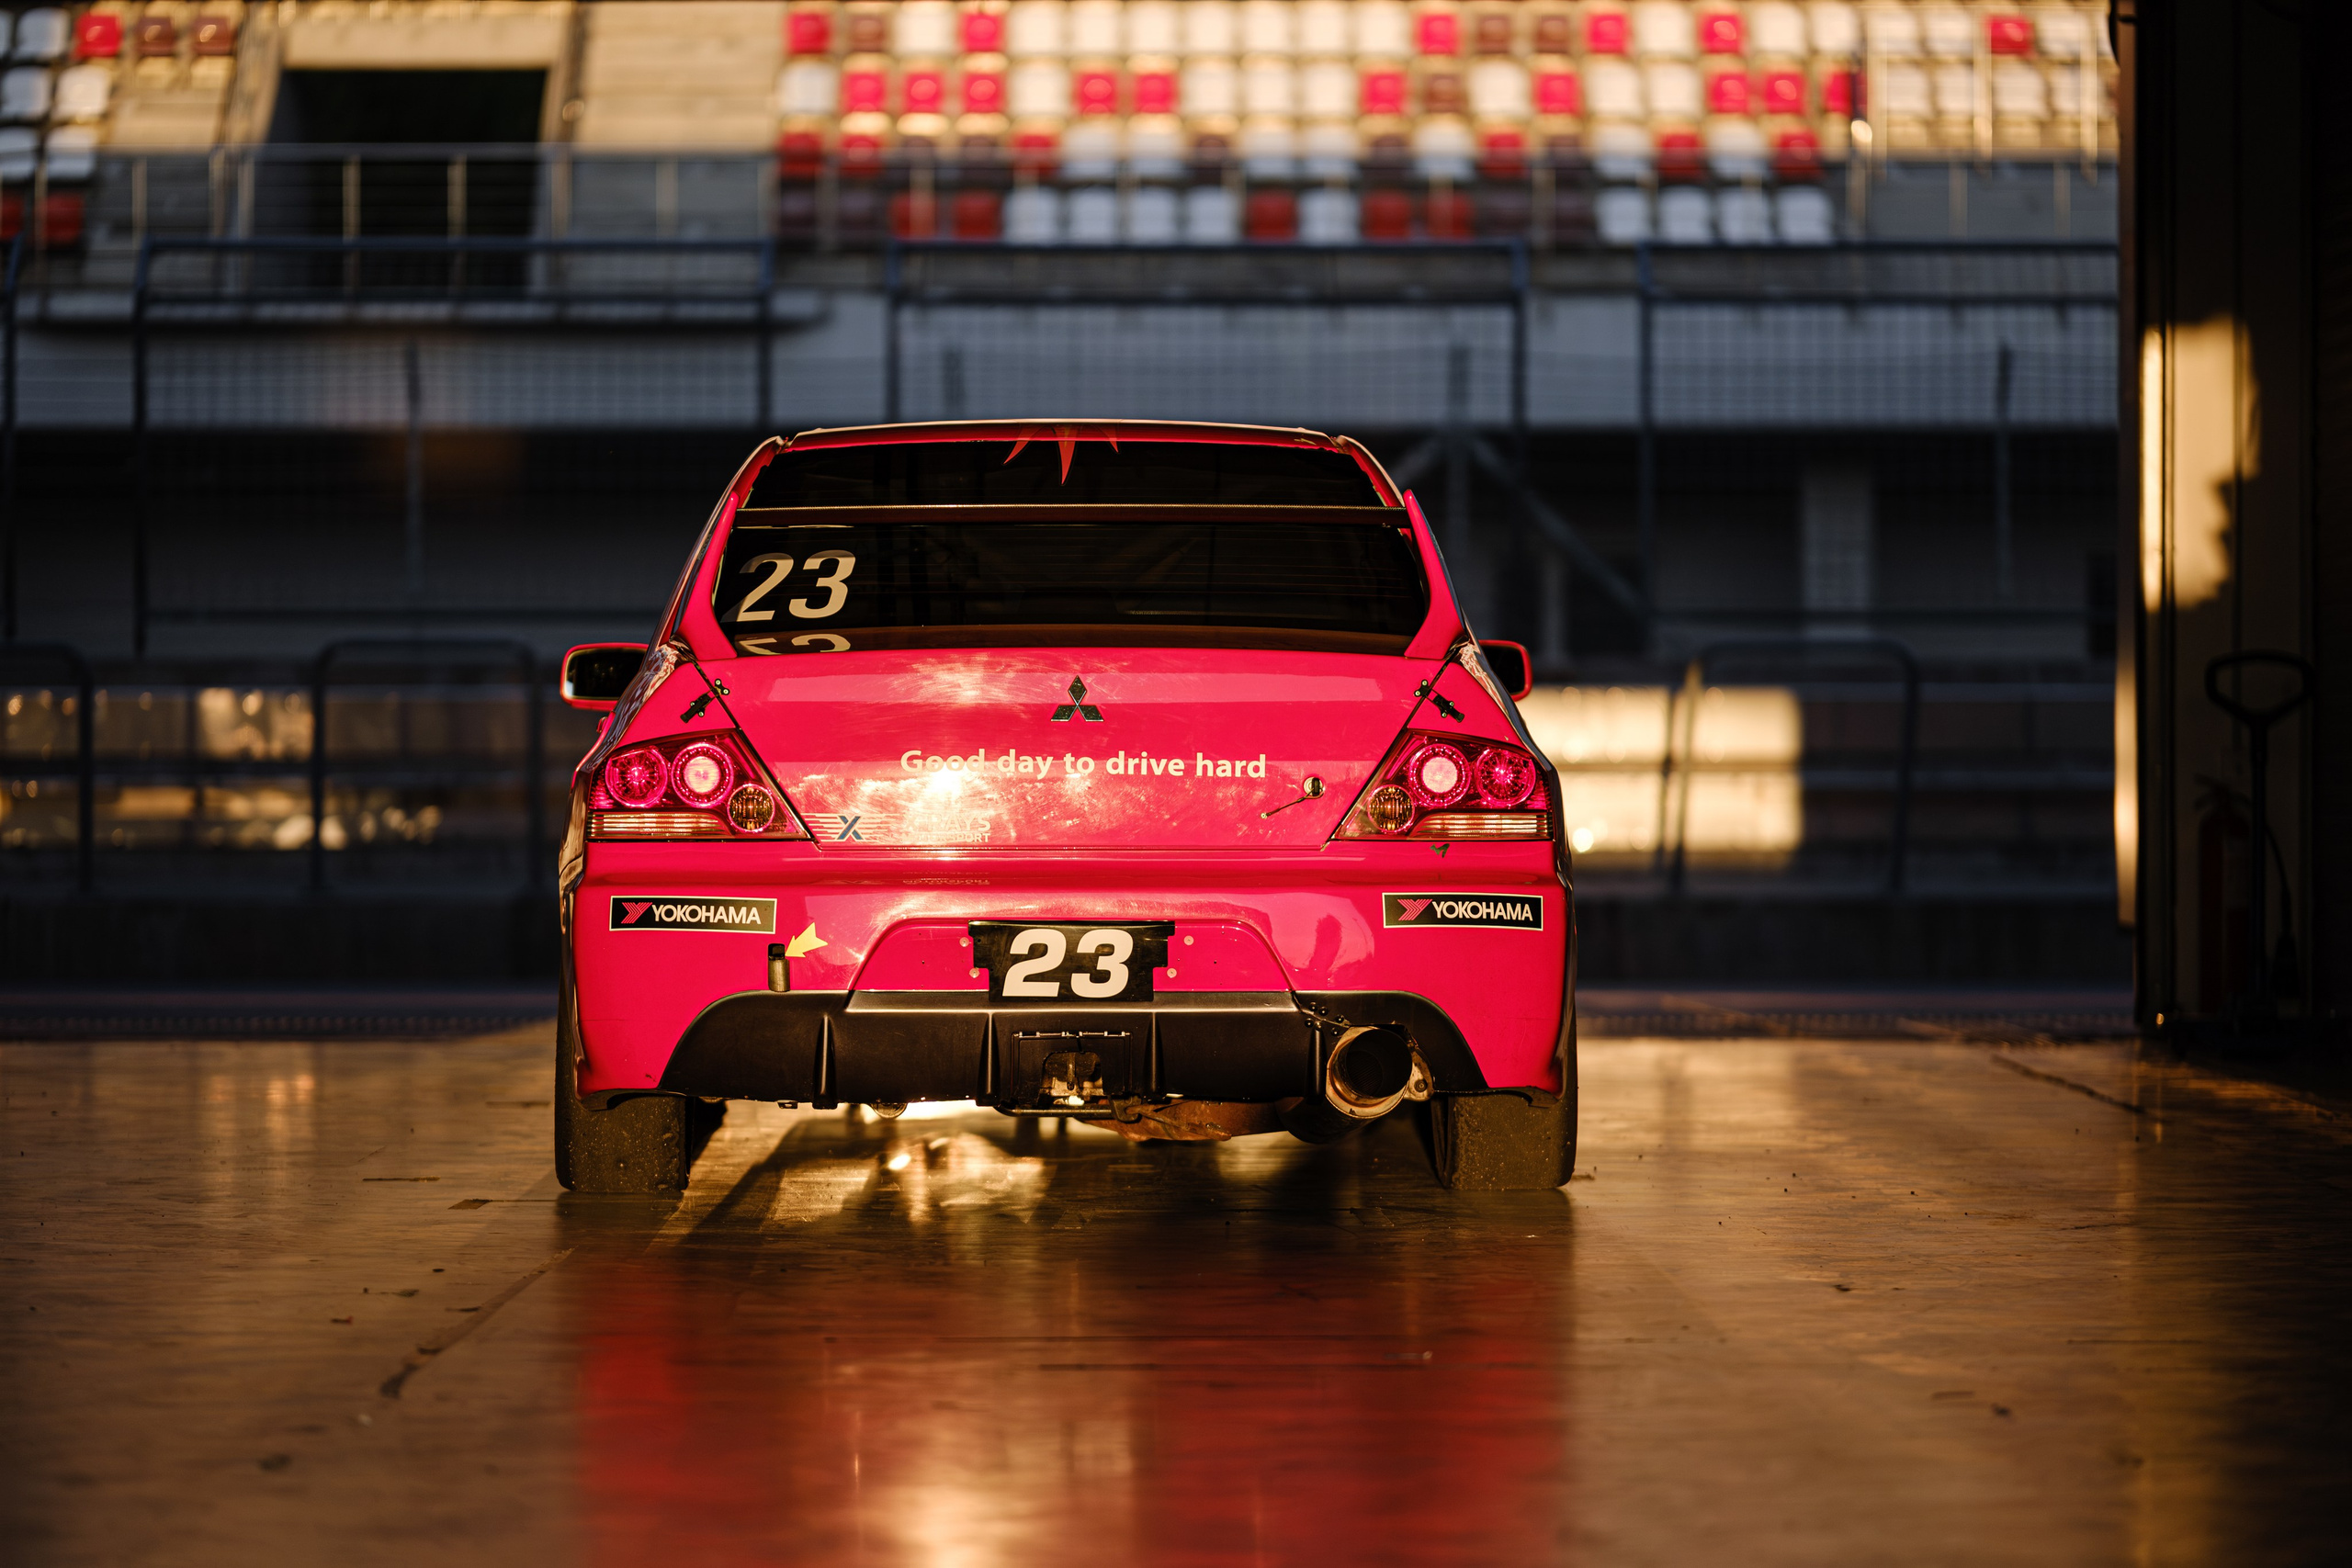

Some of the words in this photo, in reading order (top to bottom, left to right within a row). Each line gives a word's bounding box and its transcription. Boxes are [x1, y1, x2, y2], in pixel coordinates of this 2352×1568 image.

[720, 549, 856, 624] 23
[900, 749, 985, 773] Good
[997, 749, 1054, 780] day
[1063, 751, 1095, 774] to
[1105, 750, 1185, 776] drive
[1195, 752, 1266, 778] hard
[651, 904, 762, 925] YOKOHAMA
[1431, 901, 1533, 921] YOKOHAMA
[1001, 928, 1134, 998] 23
